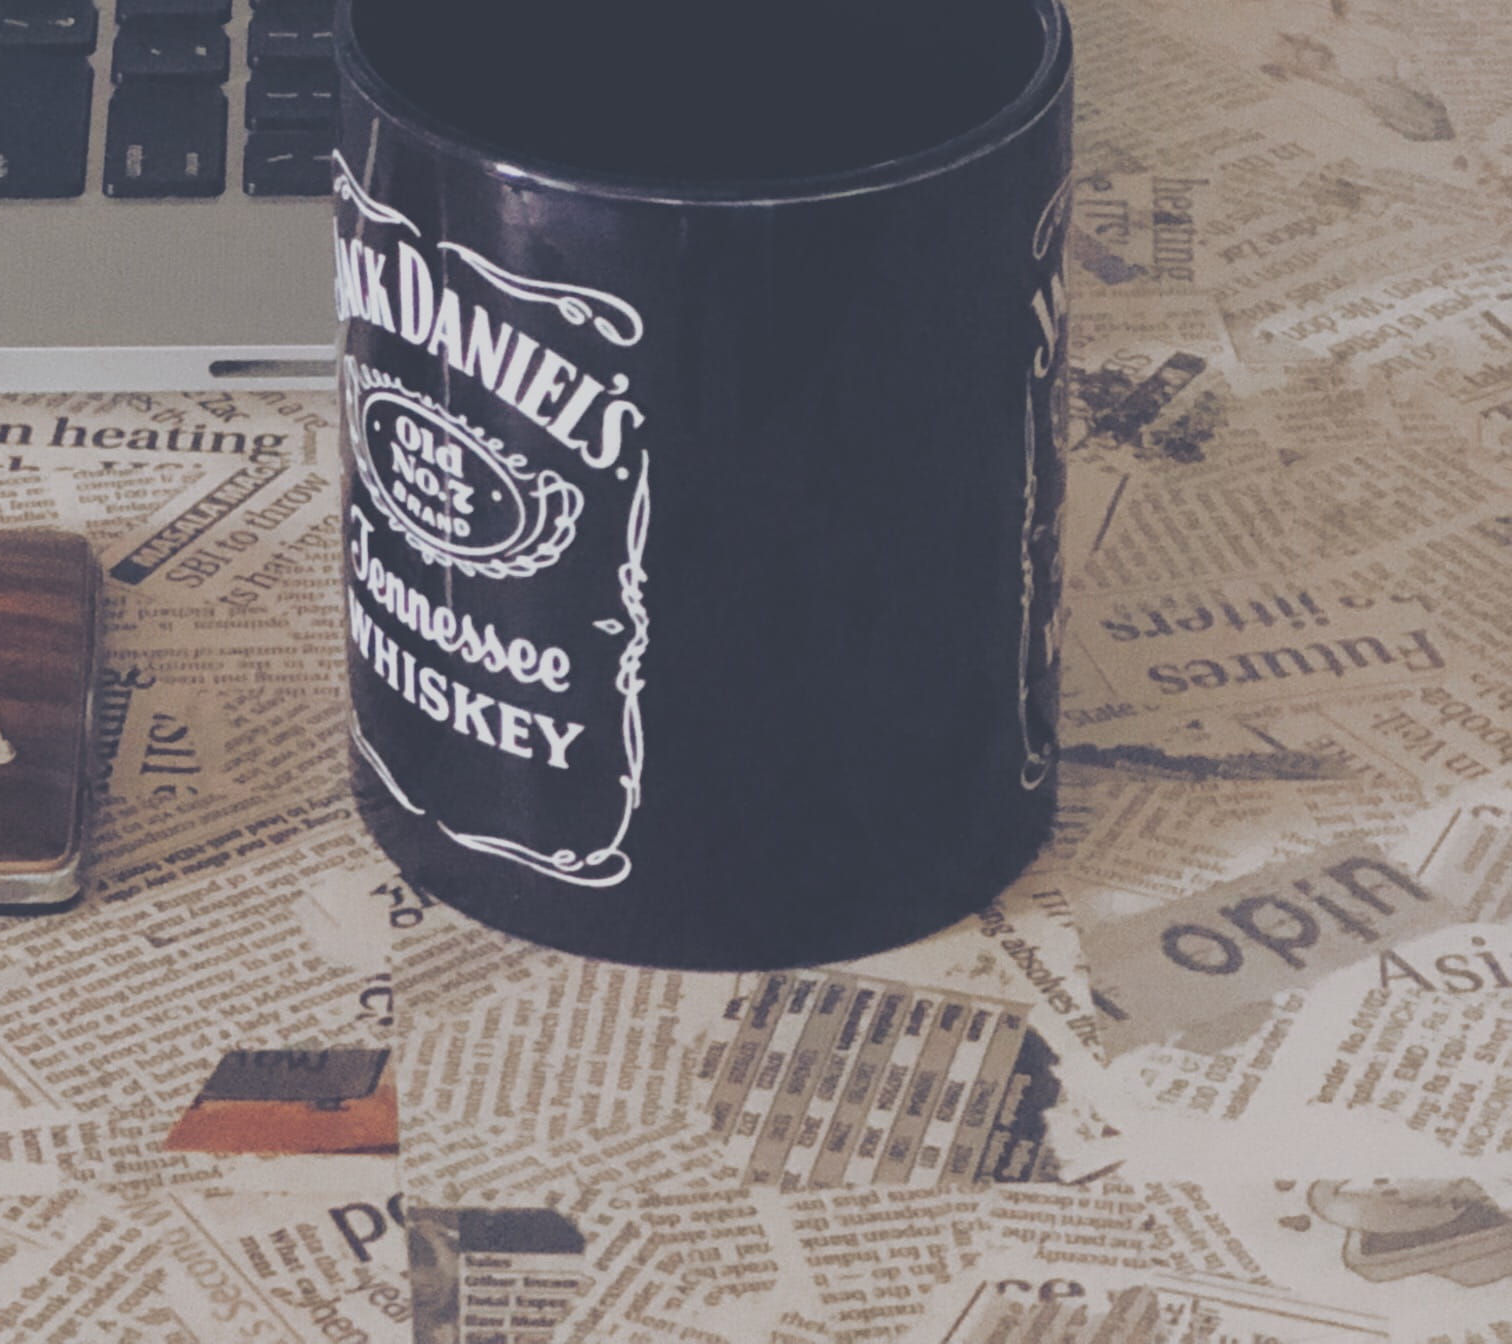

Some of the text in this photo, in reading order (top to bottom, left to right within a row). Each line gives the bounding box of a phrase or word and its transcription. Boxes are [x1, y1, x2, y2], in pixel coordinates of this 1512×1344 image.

[48, 415, 290, 458] heating
[396, 415, 465, 478] Old
[165, 470, 331, 586] SBI to throw
[392, 479, 471, 538] BRAND
[347, 585, 585, 770] WHISKEY
[1145, 627, 1445, 698] Futures
[1160, 855, 1433, 976] opin
[999, 931, 1080, 1018] absolves
